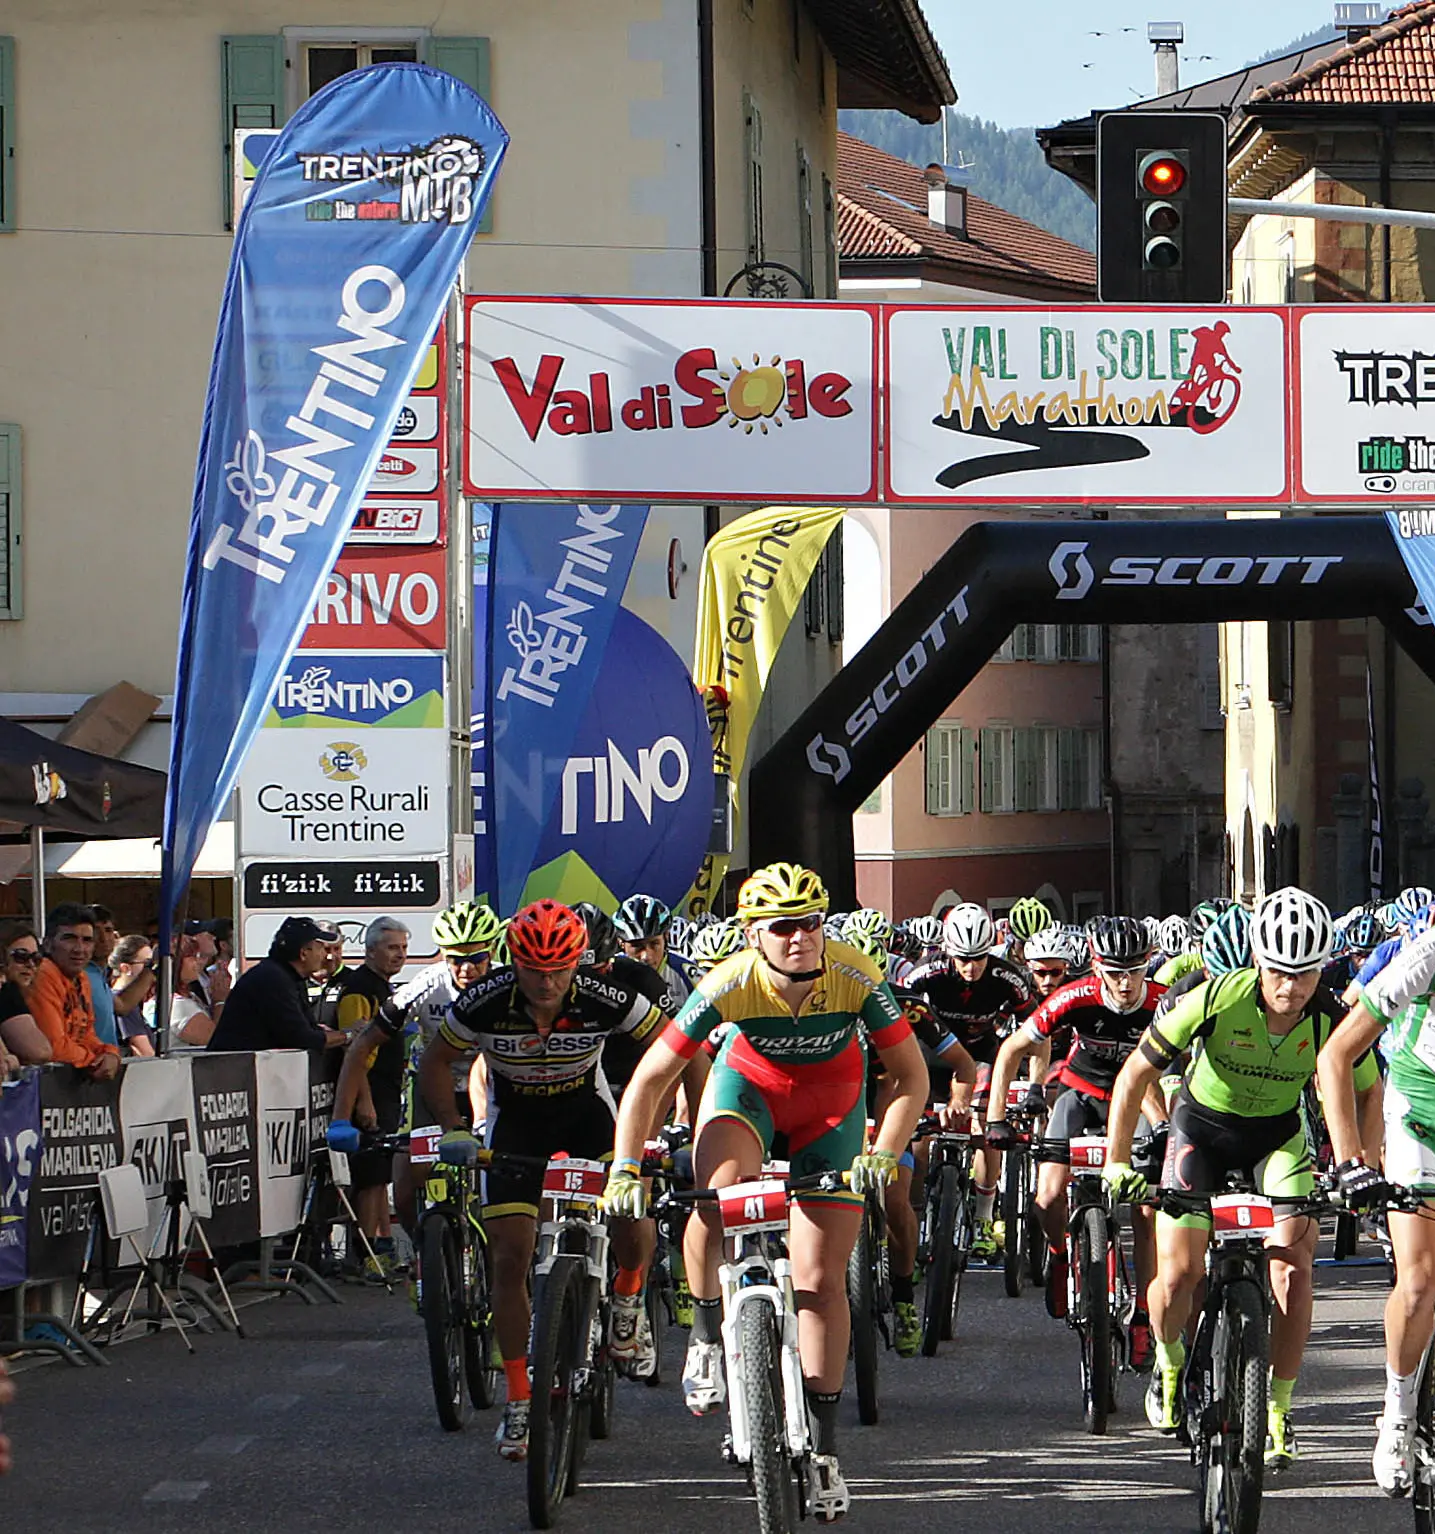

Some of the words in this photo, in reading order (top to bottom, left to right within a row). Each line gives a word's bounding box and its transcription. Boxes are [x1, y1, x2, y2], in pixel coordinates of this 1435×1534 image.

[300, 152, 463, 181] TRENTINO
[336, 201, 356, 220] the
[942, 326, 1018, 381] VAL
[1040, 326, 1076, 381] DI
[1096, 327, 1191, 381] SOLE
[490, 354, 614, 443] Val
[621, 383, 673, 430] di
[942, 364, 1172, 430] Marathon
[203, 265, 407, 584] TRENTINO
[1361, 440, 1404, 471] ride
[1101, 556, 1344, 585] SCOTT
[306, 573, 440, 625] RIVO
[845, 585, 971, 748] SCOTT
[276, 676, 414, 713] TRENTINO
[257, 785, 344, 813] Casse
[350, 785, 429, 813] Rurali
[282, 814, 405, 842] Trentine
[574, 974, 629, 1004] APPARO
[42, 1105, 116, 1139] FOLGARIDA
[40, 1143, 117, 1177] MARILLEVA
[1086, 1147, 1103, 1166] 16
[564, 1171, 583, 1190] 15
[744, 1196, 765, 1220] 41
